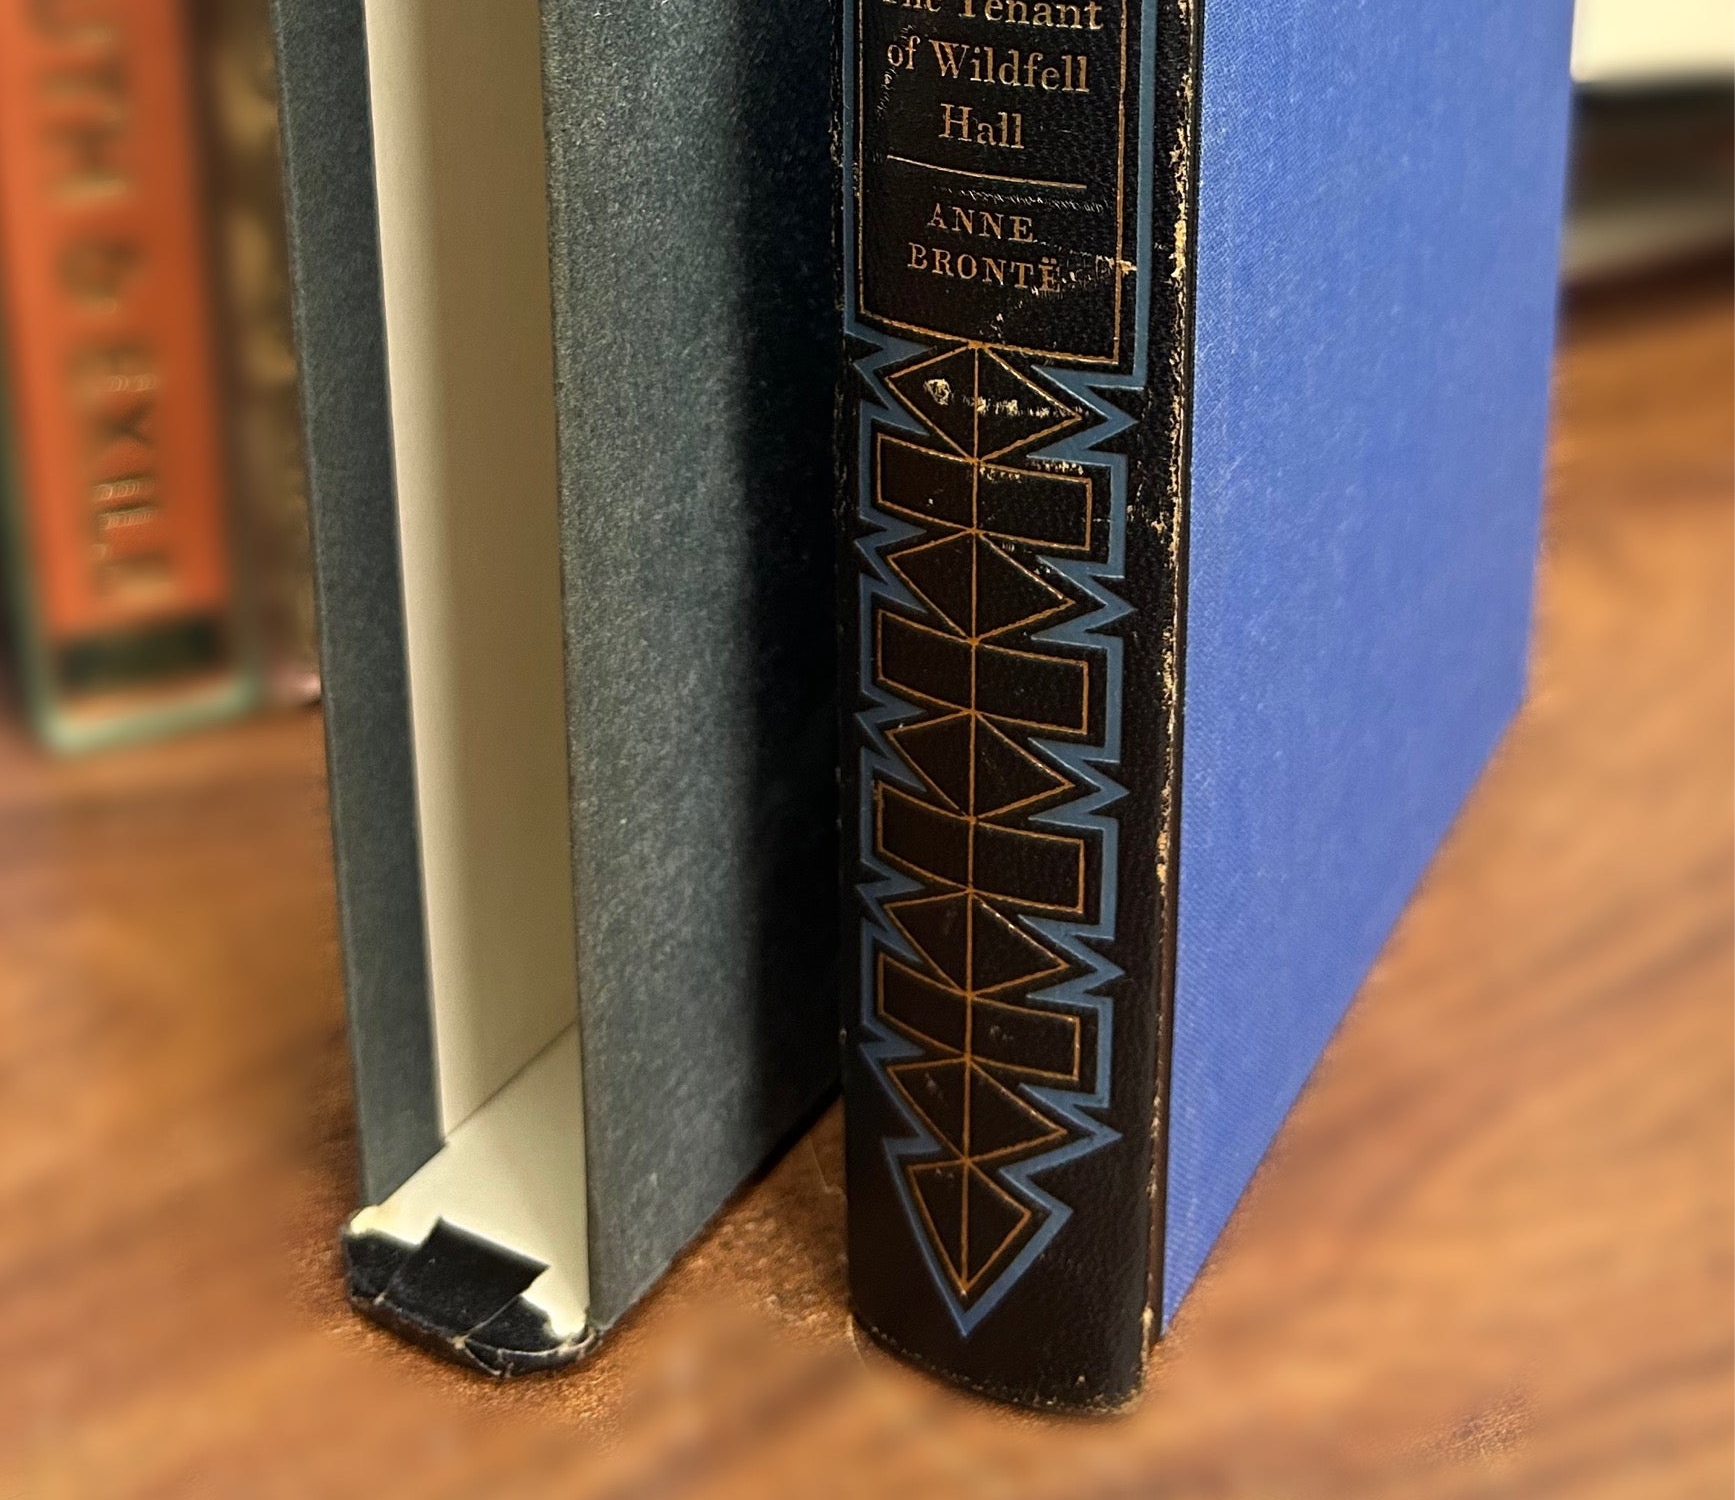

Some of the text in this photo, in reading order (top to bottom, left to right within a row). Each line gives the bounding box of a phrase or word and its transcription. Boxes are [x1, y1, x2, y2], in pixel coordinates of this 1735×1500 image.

[886, 35, 1091, 93] of Wildfell
[938, 102, 1026, 150] Hall
[926, 201, 1036, 244] ANNE
[906, 241, 1062, 294] BRONTË
